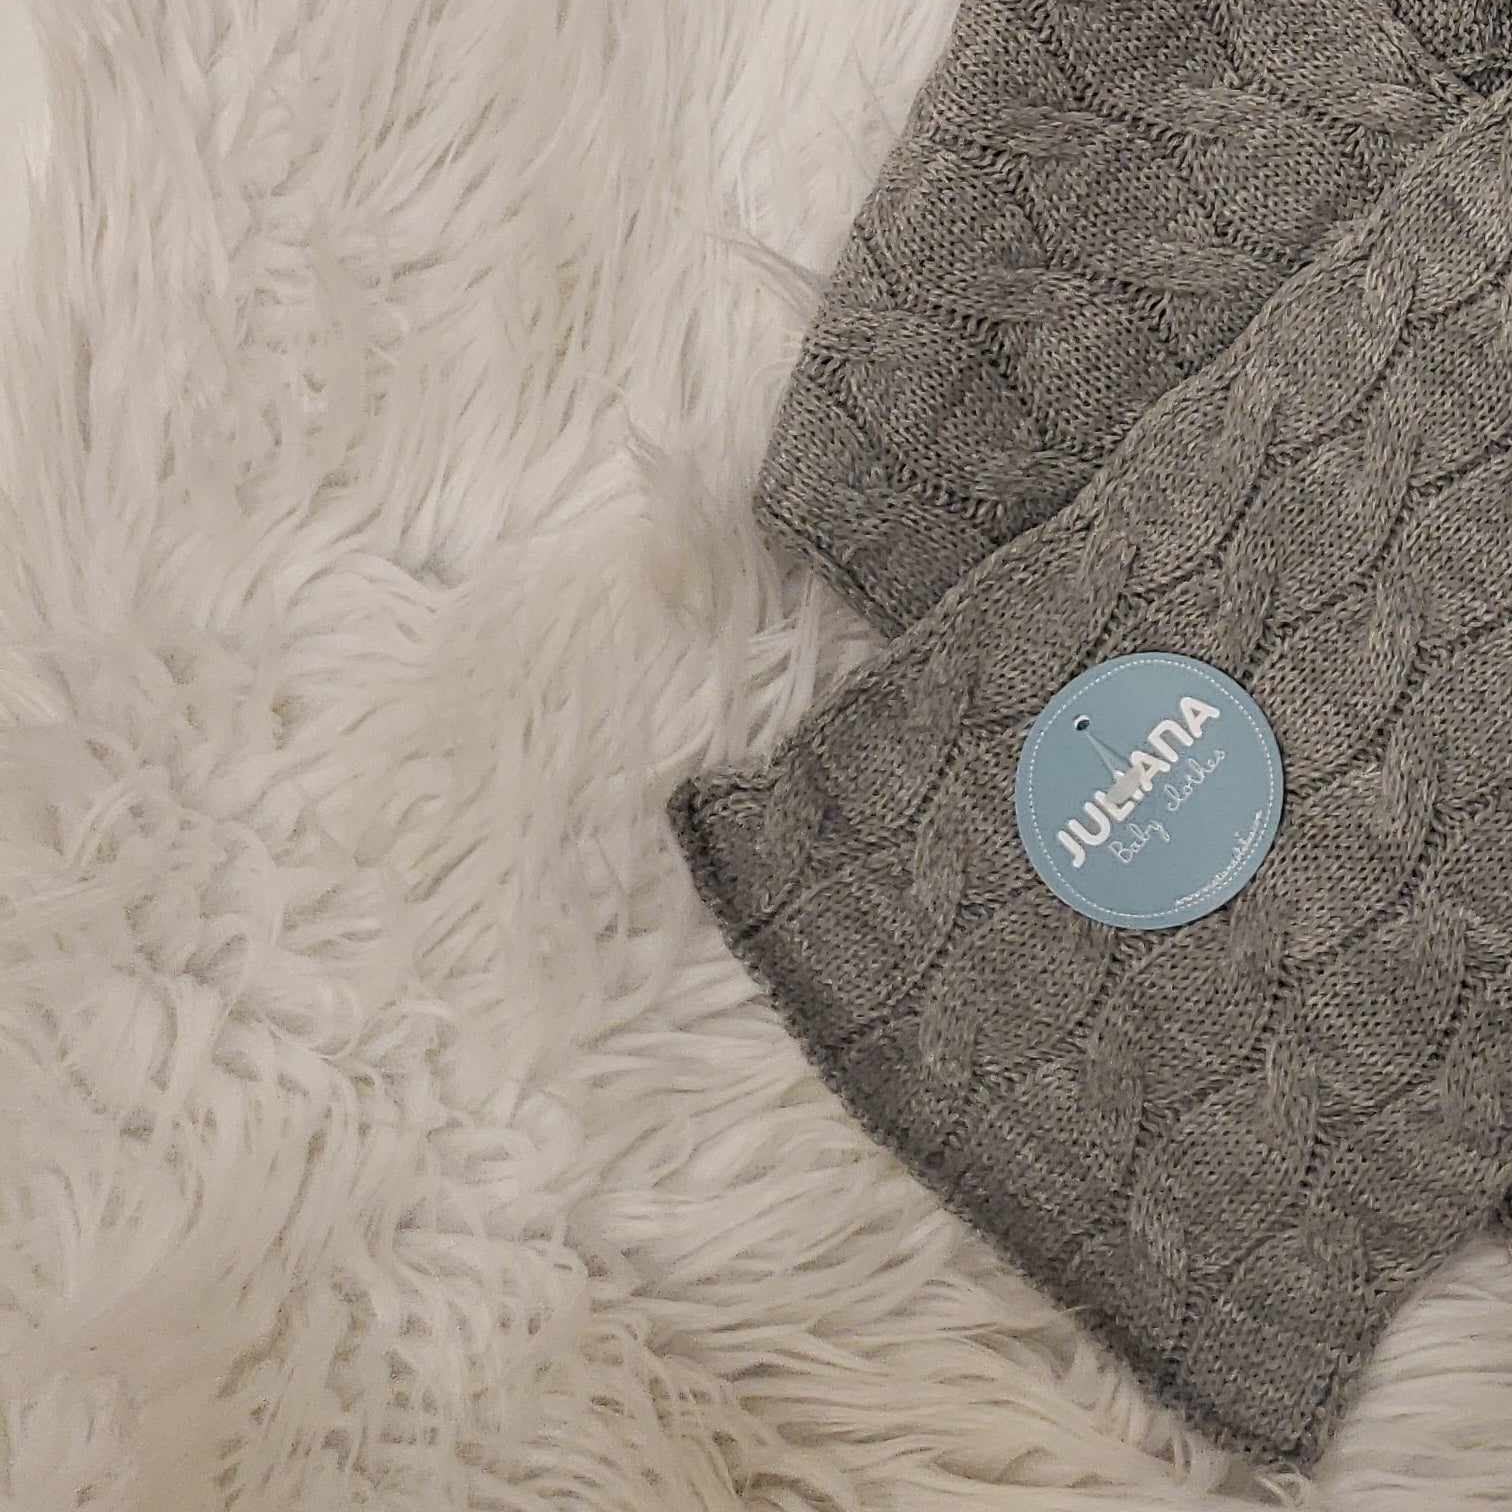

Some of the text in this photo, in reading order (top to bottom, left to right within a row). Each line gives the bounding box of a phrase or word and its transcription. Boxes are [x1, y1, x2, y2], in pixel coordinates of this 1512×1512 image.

[1057, 696, 1221, 868] JULIANA
[1108, 820, 1170, 864] Baby
[1164, 748, 1226, 812] clothes
